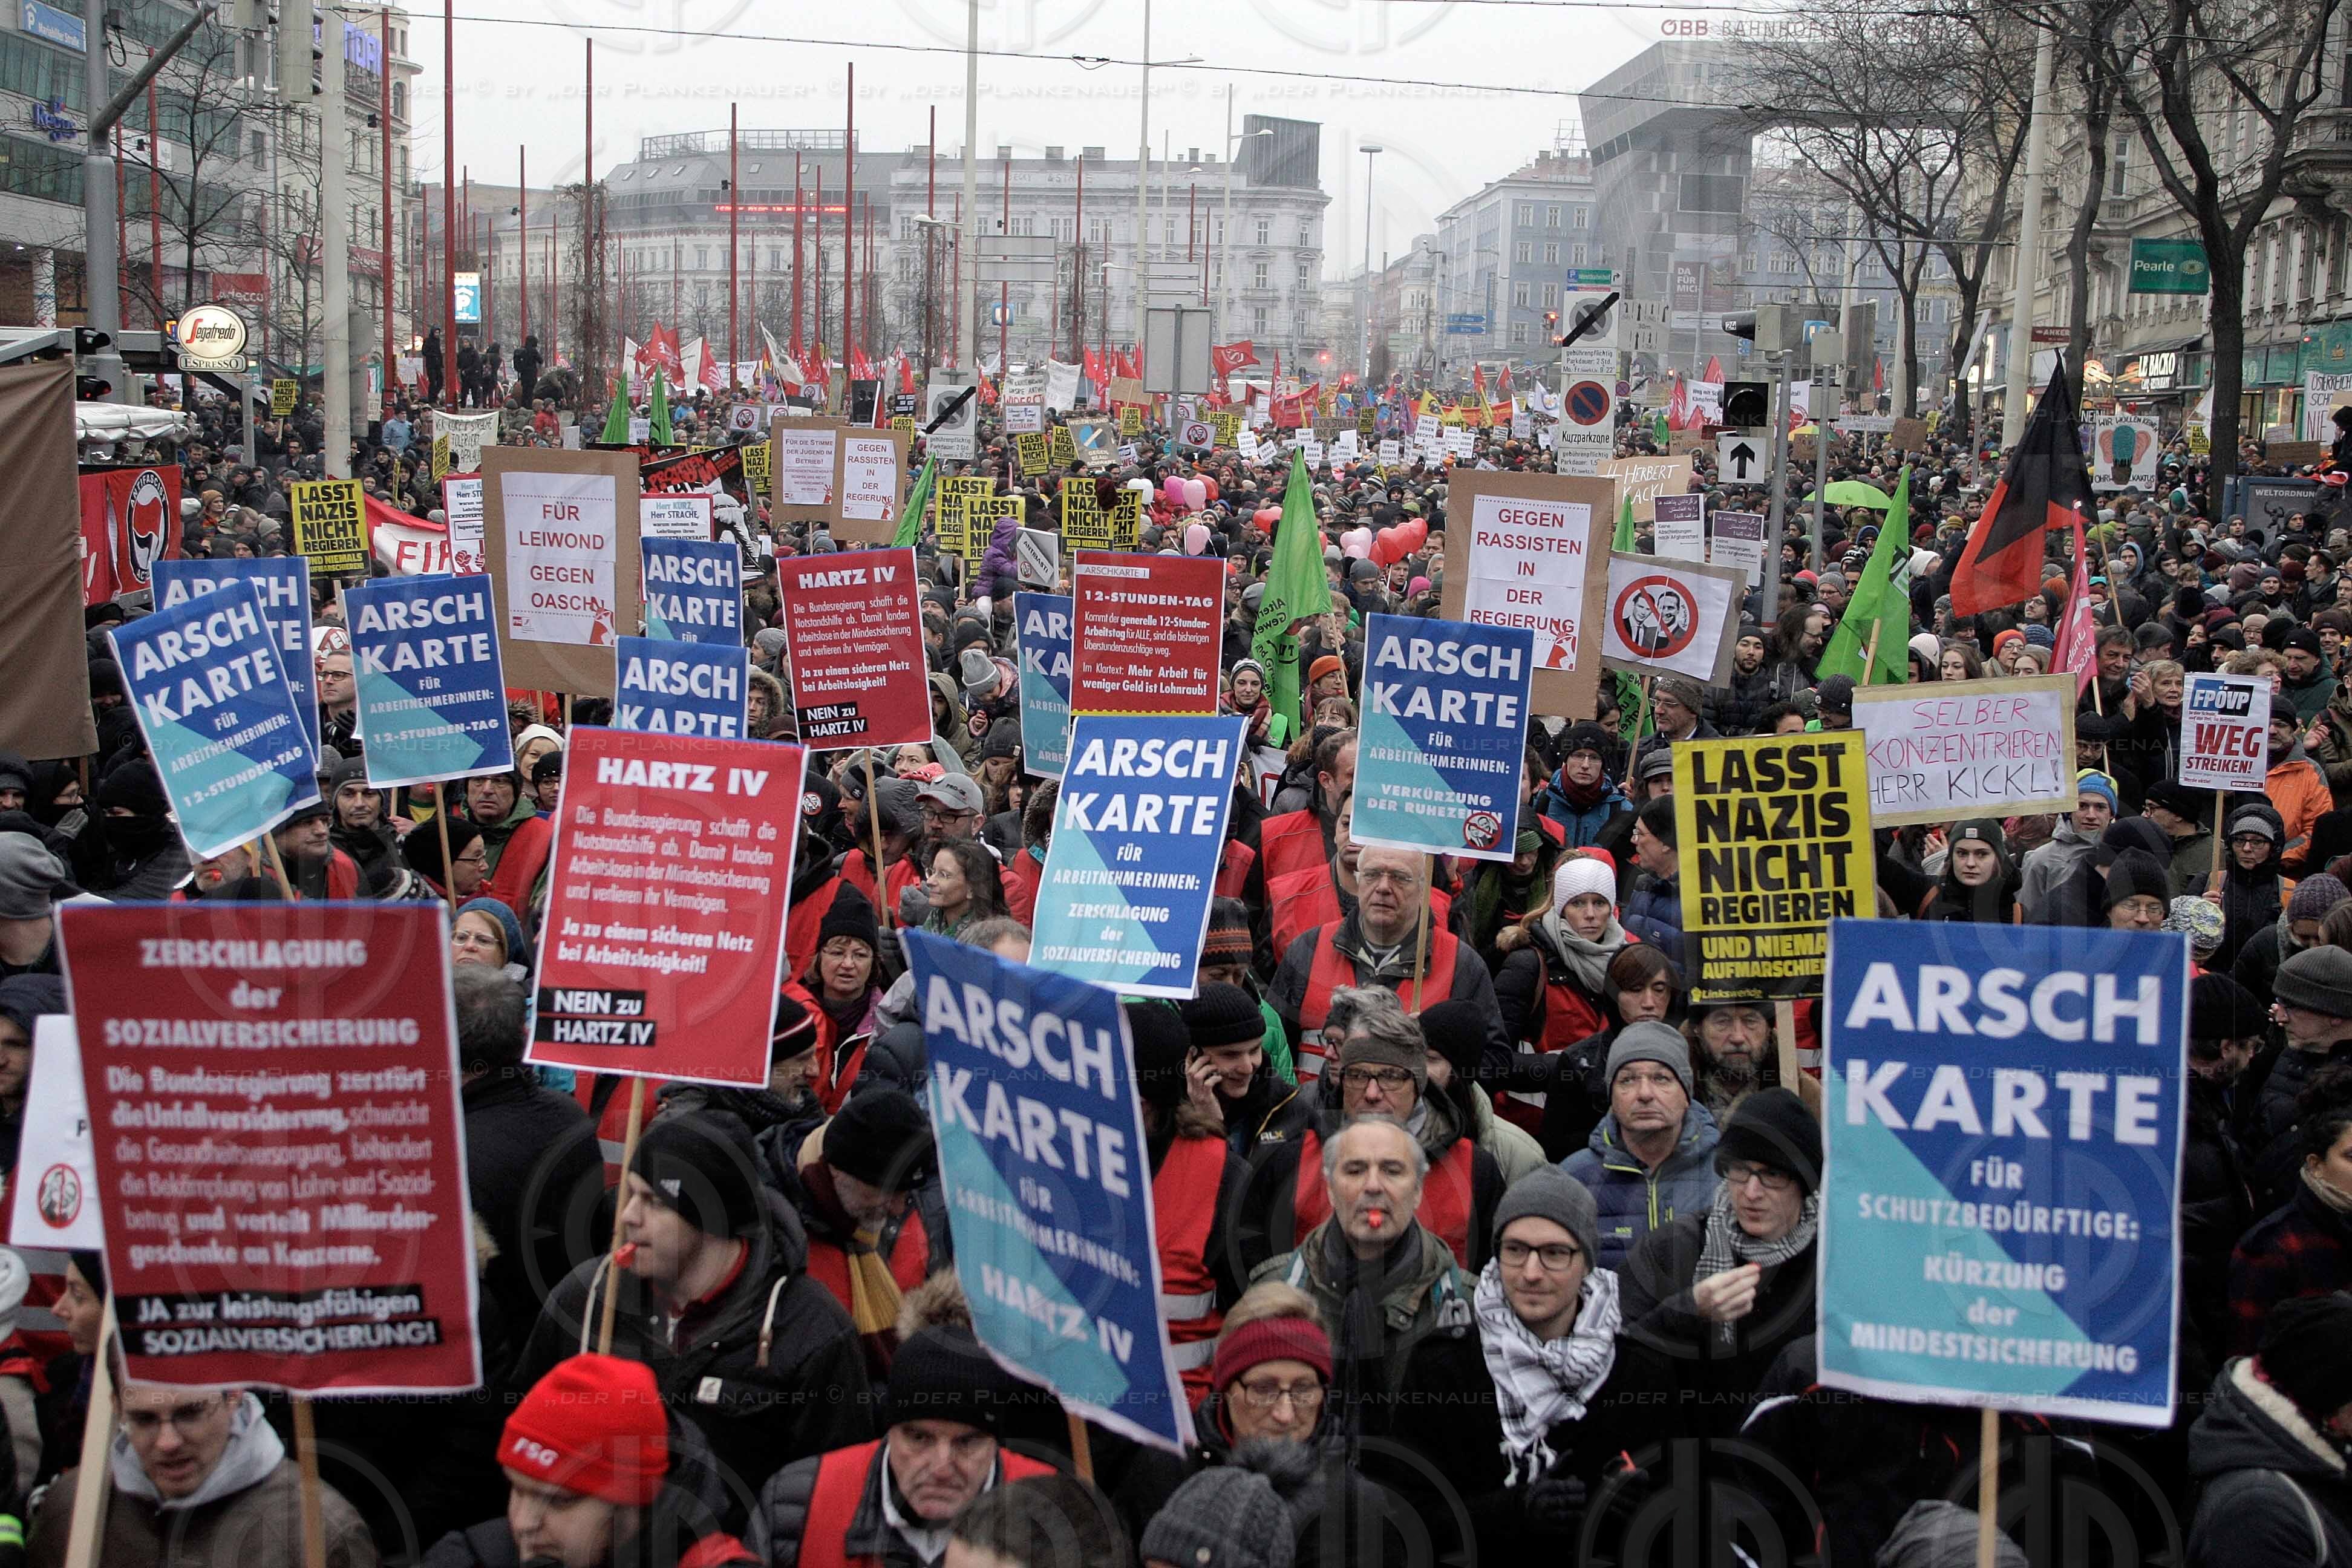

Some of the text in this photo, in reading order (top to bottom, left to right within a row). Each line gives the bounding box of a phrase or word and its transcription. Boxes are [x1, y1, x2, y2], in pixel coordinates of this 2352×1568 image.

[2134, 260, 2174, 272] Pearle
[1677, 275, 1696, 284] FÜR
[217, 289, 264, 302] Adecco
[185, 318, 236, 344] Segafredo
[1725, 321, 1736, 330] 24
[275, 380, 295, 388] LASST
[2098, 417, 2113, 427] WIR
[2115, 416, 2141, 425] WOLLEN
[857, 443, 887, 453] GEGEN
[1021, 434, 1043, 444] LASST
[1021, 443, 1045, 452] NAZIS
[1562, 430, 1610, 445] Kurzparkzone
[847, 455, 895, 465] RASSISTEN
[1023, 450, 1046, 460] NICHT
[866, 468, 875, 477] IN
[1624, 464, 1680, 485] HERBERT
[298, 483, 355, 503] LASST
[846, 492, 893, 503] REGIERUNG
[861, 482, 879, 490] DER
[299, 500, 359, 521] NAZIS
[542, 500, 581, 521] FÜR
[656, 501, 671, 510] Herr
[970, 500, 1019, 515] LASST
[301, 519, 359, 540] NICHT
[1067, 511, 1110, 527] NICHT
[1498, 508, 1564, 528] GEGEN
[518, 530, 605, 550] LEIWOND
[1067, 526, 1109, 538] REGIEREN
[1476, 531, 1582, 555] RASSISTEN
[303, 537, 362, 552] REGIEREN
[530, 564, 595, 584] GEGEN
[647, 554, 734, 588] ARSCH
[798, 565, 896, 589] HARTZ IV
[1083, 566, 1139, 577] ARSCHKARTE
[1517, 561, 1535, 577] IN
[1506, 589, 1543, 606] DER
[356, 592, 486, 634] ARSCH
[650, 592, 737, 628] KARTE
[1469, 609, 1575, 633] REGIERUNG
[134, 601, 261, 681] ARSCH
[361, 632, 492, 676] KARTE
[1373, 635, 1520, 681] ARSCH
[143, 647, 278, 728] KARTE
[419, 675, 442, 691] FÜR
[622, 656, 739, 702] ARSCH
[1371, 681, 1518, 729] KARTE
[2192, 685, 2250, 710] FPÖVP
[213, 710, 240, 732] FÜR
[621, 703, 738, 739] KARTE
[806, 706, 856, 721] NEIN zu
[1912, 697, 2030, 730] SELBER
[809, 719, 865, 737] HARTZ IV
[1428, 731, 1452, 748] FÜR
[1867, 730, 2062, 771] KONZENTRIEREN
[2194, 723, 2264, 759] WEG
[1073, 737, 1229, 779] ARSCH
[1691, 742, 1846, 795] LASST
[2185, 756, 2253, 774] STREIKEN!
[596, 756, 769, 797] HARTZ IV
[1947, 759, 2062, 801] KICKL!
[1367, 797, 1398, 812] DER
[1381, 783, 1492, 807] VERKÜRZUNG
[1063, 792, 1220, 836] KARTE
[1695, 791, 1851, 844] NAZIS
[1116, 843, 1143, 862] FÜR
[1699, 841, 1855, 893] NICHT
[1067, 903, 1170, 924] ZERSCHLAGUNG
[1701, 890, 1855, 926] REGIEREN
[1100, 926, 1124, 942] der
[140, 938, 368, 969] ZERSCHLAGUNG
[1042, 946, 1181, 969] SOZIALVERSICHERUNG
[1701, 936, 1751, 959] UND
[229, 981, 284, 1009] der
[554, 990, 642, 1015] NEIN zu
[1843, 961, 2162, 1046] ARSCH
[103, 1018, 421, 1049] SOZIALVERSICHERUNG
[554, 1019, 655, 1047] HARTZ IV
[924, 974, 1117, 1102] ARSCH
[1844, 1059, 2161, 1146] KARTE
[934, 1060, 1132, 1199] KARTE
[1970, 1155, 2024, 1189] FÜR
[1858, 1192, 2140, 1242] SCHUTZBEDÜRFTIGE:
[1923, 1253, 2067, 1293] KÜRZUNG
[137, 1289, 420, 1328] JA zur leistungsfähigen
[981, 1263, 1134, 1364] HARTZ IV
[1967, 1297, 2019, 1327] der
[144, 1319, 438, 1355] SOZIALVERSICHERUNG!
[1850, 1321, 2137, 1374] MINDESTSICHERUNG
[511, 1436, 559, 1467] FSG
